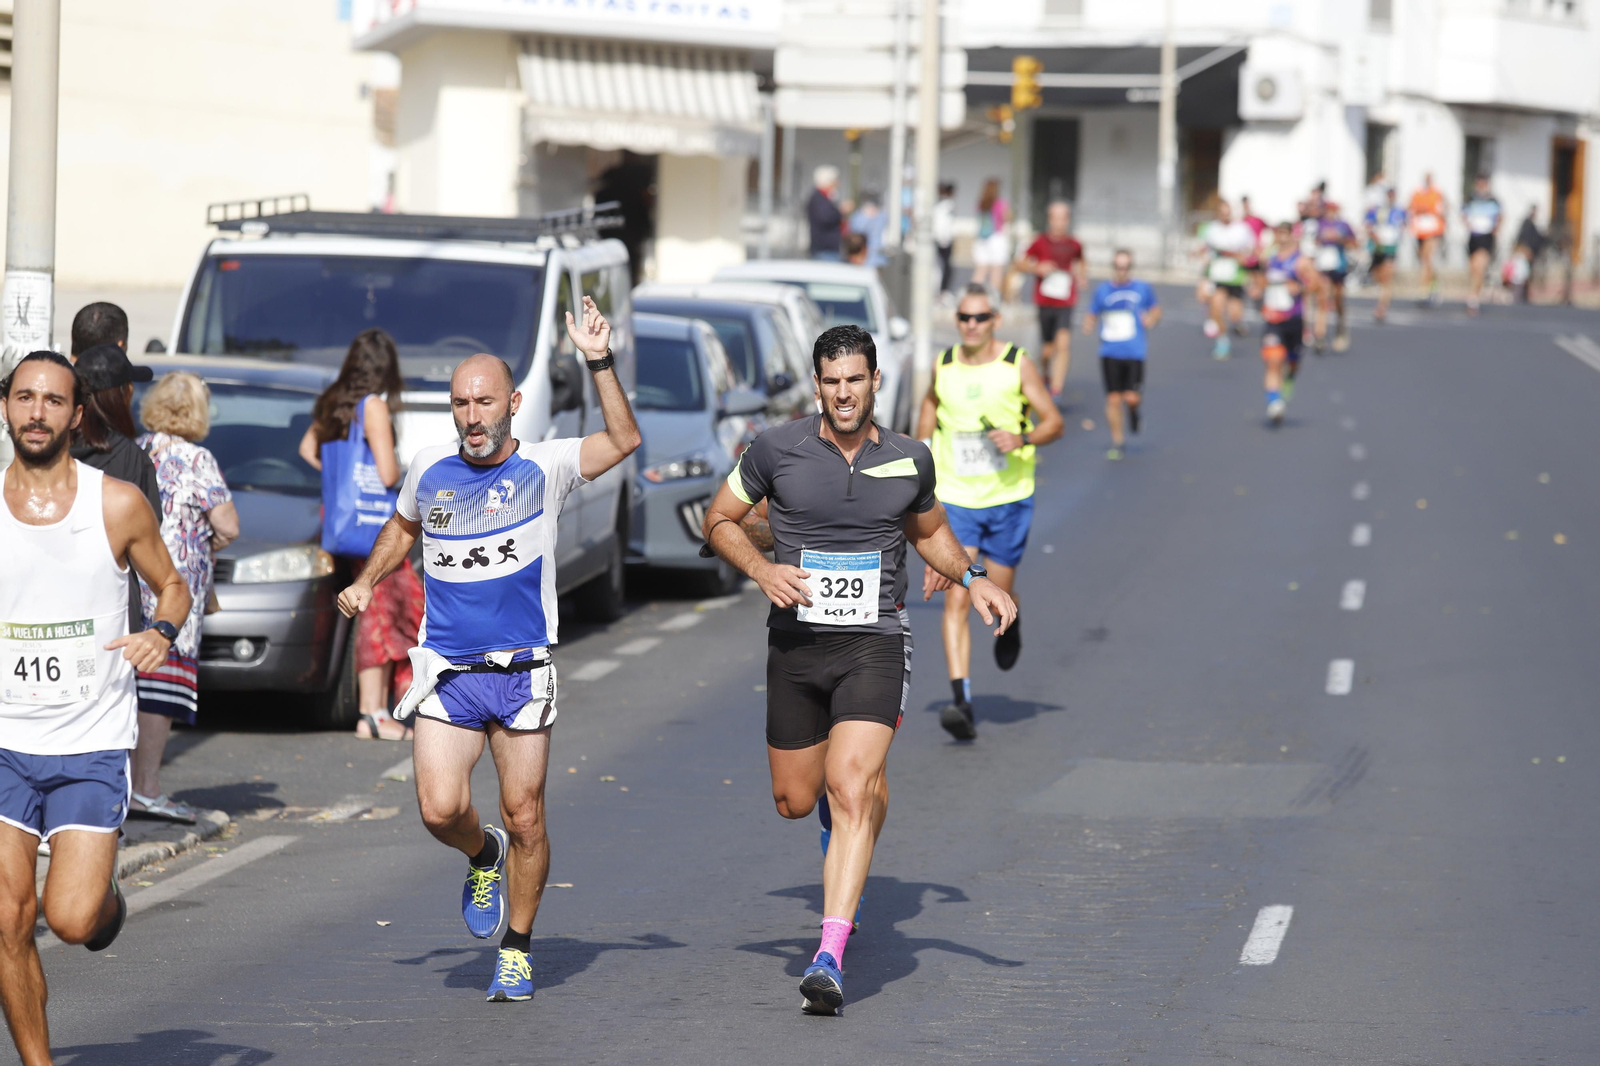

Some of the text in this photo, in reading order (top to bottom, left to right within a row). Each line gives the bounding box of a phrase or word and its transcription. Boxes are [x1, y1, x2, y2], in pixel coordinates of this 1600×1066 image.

[820, 577, 864, 599] 329
[824, 608, 856, 616] KIA
[13, 626, 44, 639] VUELTA
[46, 626, 53, 638] A
[55, 624, 87, 638] HUELVA
[14, 656, 61, 682] 416
